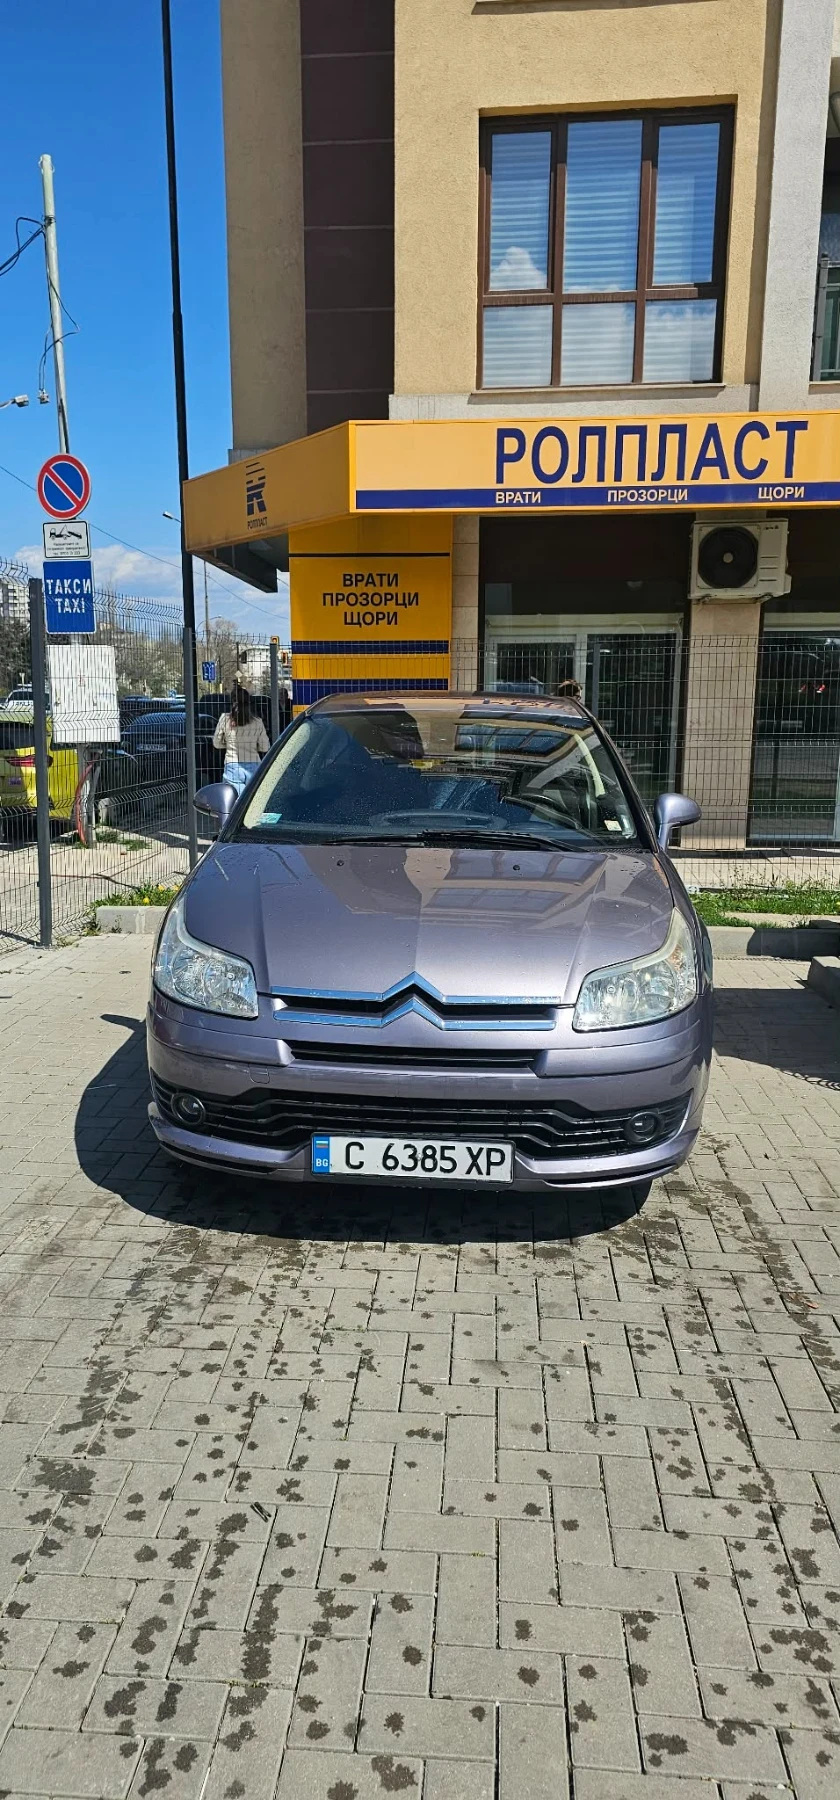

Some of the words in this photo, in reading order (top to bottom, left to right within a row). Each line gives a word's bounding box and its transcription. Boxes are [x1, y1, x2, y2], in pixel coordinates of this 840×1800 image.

[496, 421, 808, 484] РОЛПЛАСТ
[495, 491, 541, 504] ВРАТИ
[607, 489, 688, 503] ПРОЗОРЦИ
[758, 486, 805, 501] ЩОРИ
[46, 578, 91, 595] ТАКСИ
[342, 573, 399, 587] ВРАТИ
[55, 597, 86, 614] TAXI
[322, 592, 419, 608] ПРОЗОРЦИ
[343, 611, 398, 628] ЩОРИ
[315, 1158, 329, 1167] BG
[382, 1143, 458, 1173] 6385
